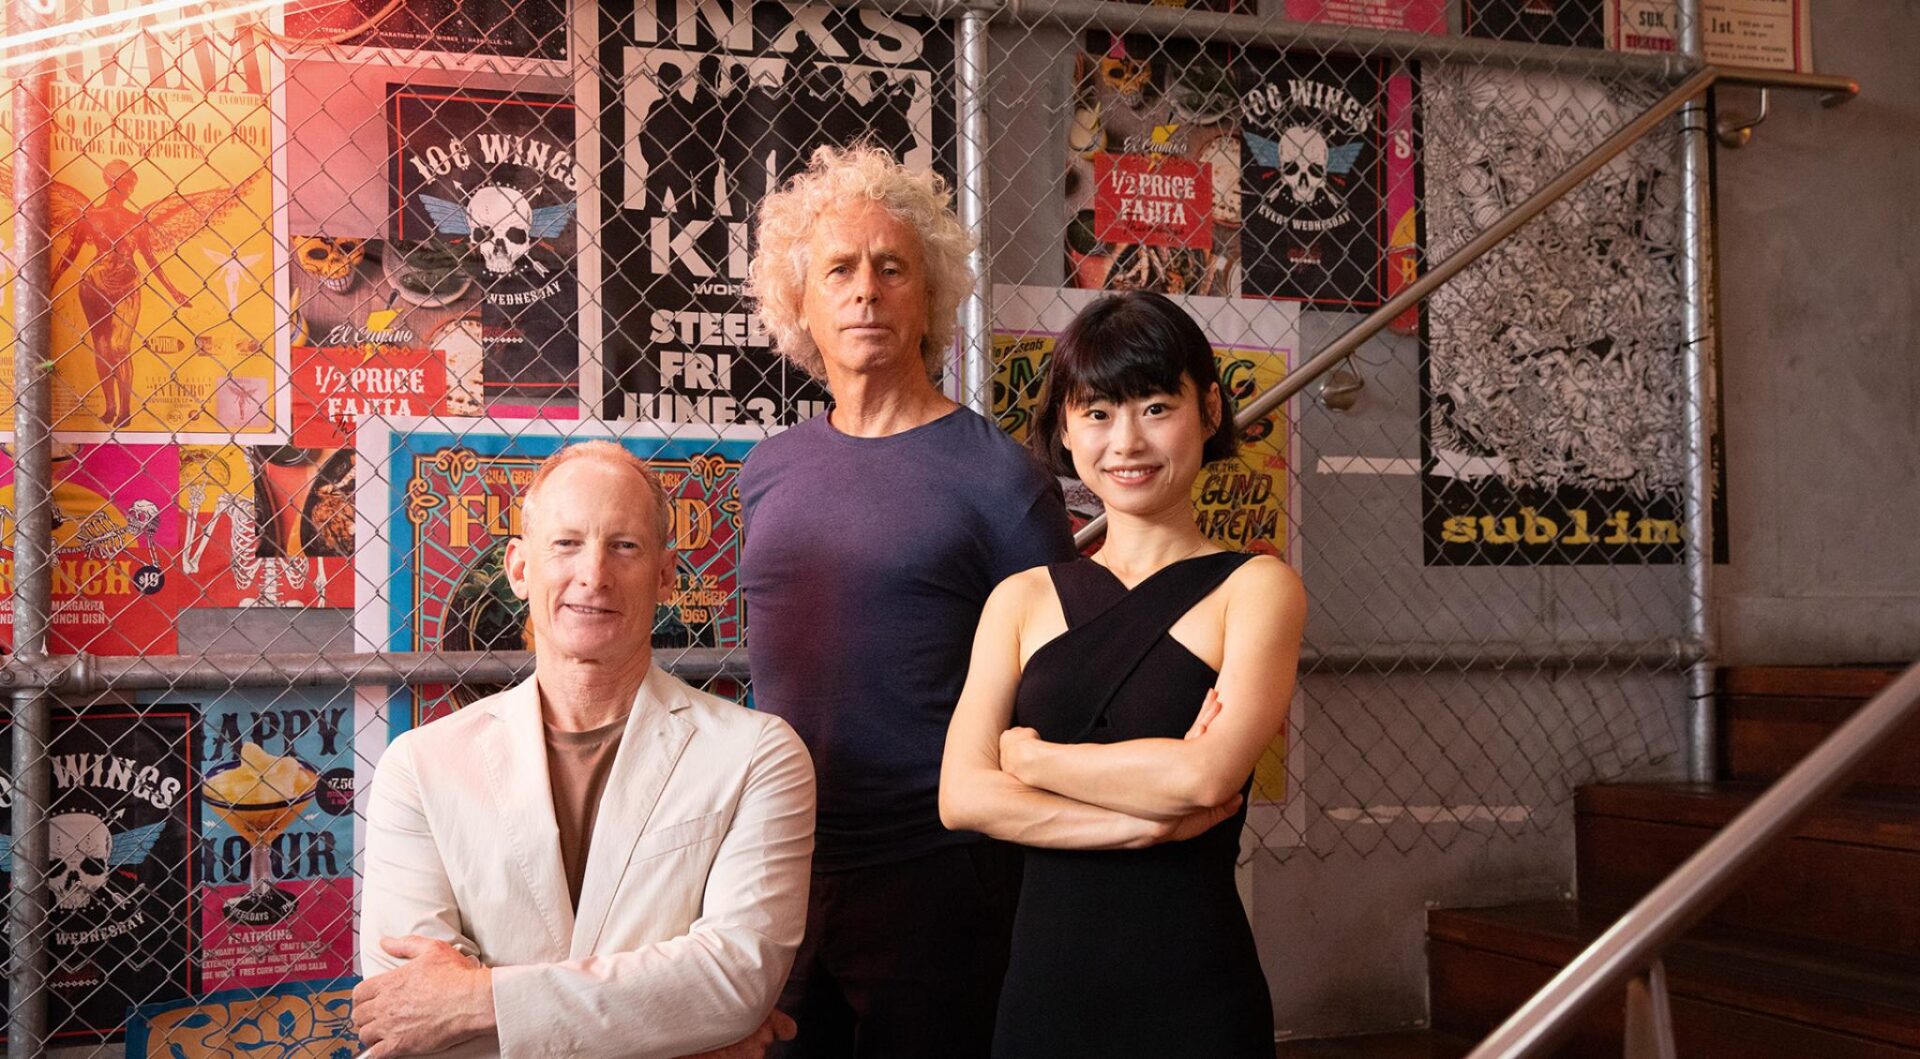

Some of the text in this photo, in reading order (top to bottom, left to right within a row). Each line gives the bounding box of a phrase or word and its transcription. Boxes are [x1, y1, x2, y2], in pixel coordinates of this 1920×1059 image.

[633, 0, 925, 64] INXS
[110, 119, 197, 143] FEBRERO
[1139, 173, 1196, 199] PRICE
[315, 366, 425, 394] 1/2 PRICE
[659, 350, 731, 391] FRI
[616, 392, 737, 425] JUNE
[746, 397, 776, 426] 3
[1200, 469, 1273, 508] GUND
[1195, 505, 1279, 545] ARENA
[702, 574, 718, 589] 22
[51, 601, 105, 612] MARGARITA
[82, 614, 105, 624] DISH
[681, 608, 708, 624] 1969
[51, 751, 182, 810] WINGS
[229, 906, 269, 922] EEKDAYS
[227, 929, 293, 945] FEATURING
